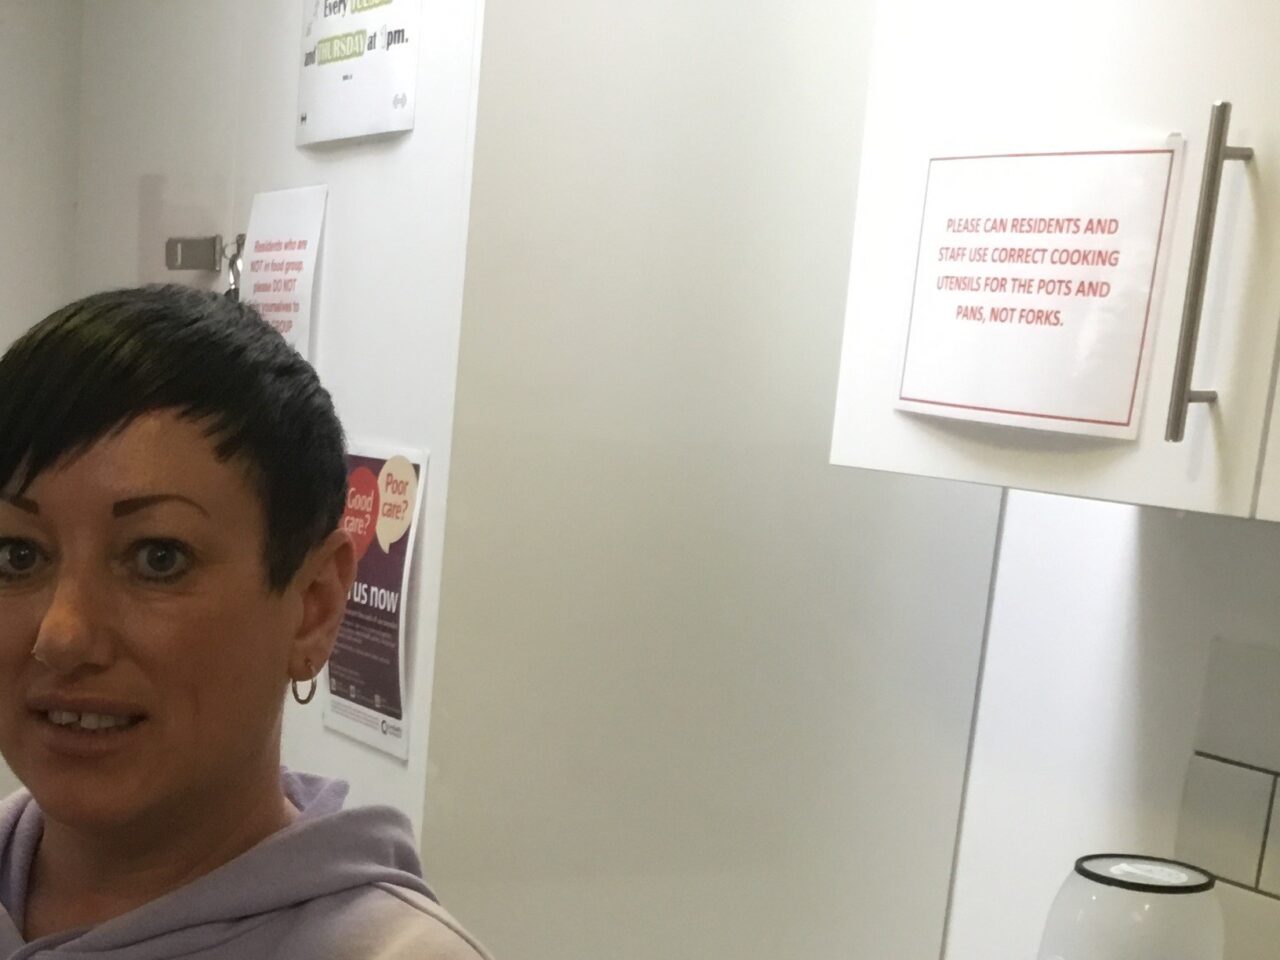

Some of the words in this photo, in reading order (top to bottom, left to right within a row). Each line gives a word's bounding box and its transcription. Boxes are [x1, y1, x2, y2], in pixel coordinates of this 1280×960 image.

[304, 45, 316, 67] and
[318, 33, 367, 62] THURSDAY
[367, 31, 377, 51] at
[946, 218, 980, 233] PLEASE
[983, 218, 1008, 233] CAN
[1010, 218, 1081, 234] RESIDENTS
[1083, 218, 1119, 235] AND
[937, 246, 967, 262] STAFF
[968, 247, 989, 263] USE
[991, 248, 1048, 264] CORRECT
[1050, 248, 1120, 267] COOKING
[936, 275, 981, 292] UTENSILS
[983, 277, 1008, 293] FOR
[1010, 278, 1035, 294] THE
[1037, 279, 1072, 297] POTS
[1075, 281, 1111, 298] AND
[956, 305, 986, 324] PANS,
[989, 307, 1017, 323] NOT
[1018, 308, 1064, 327] FORKS.
[384, 473, 410, 497] Poor
[347, 487, 375, 513] Good
[382, 500, 408, 521] care?
[343, 514, 371, 536] care?
[353, 581, 368, 605] us
[369, 586, 399, 613] now
